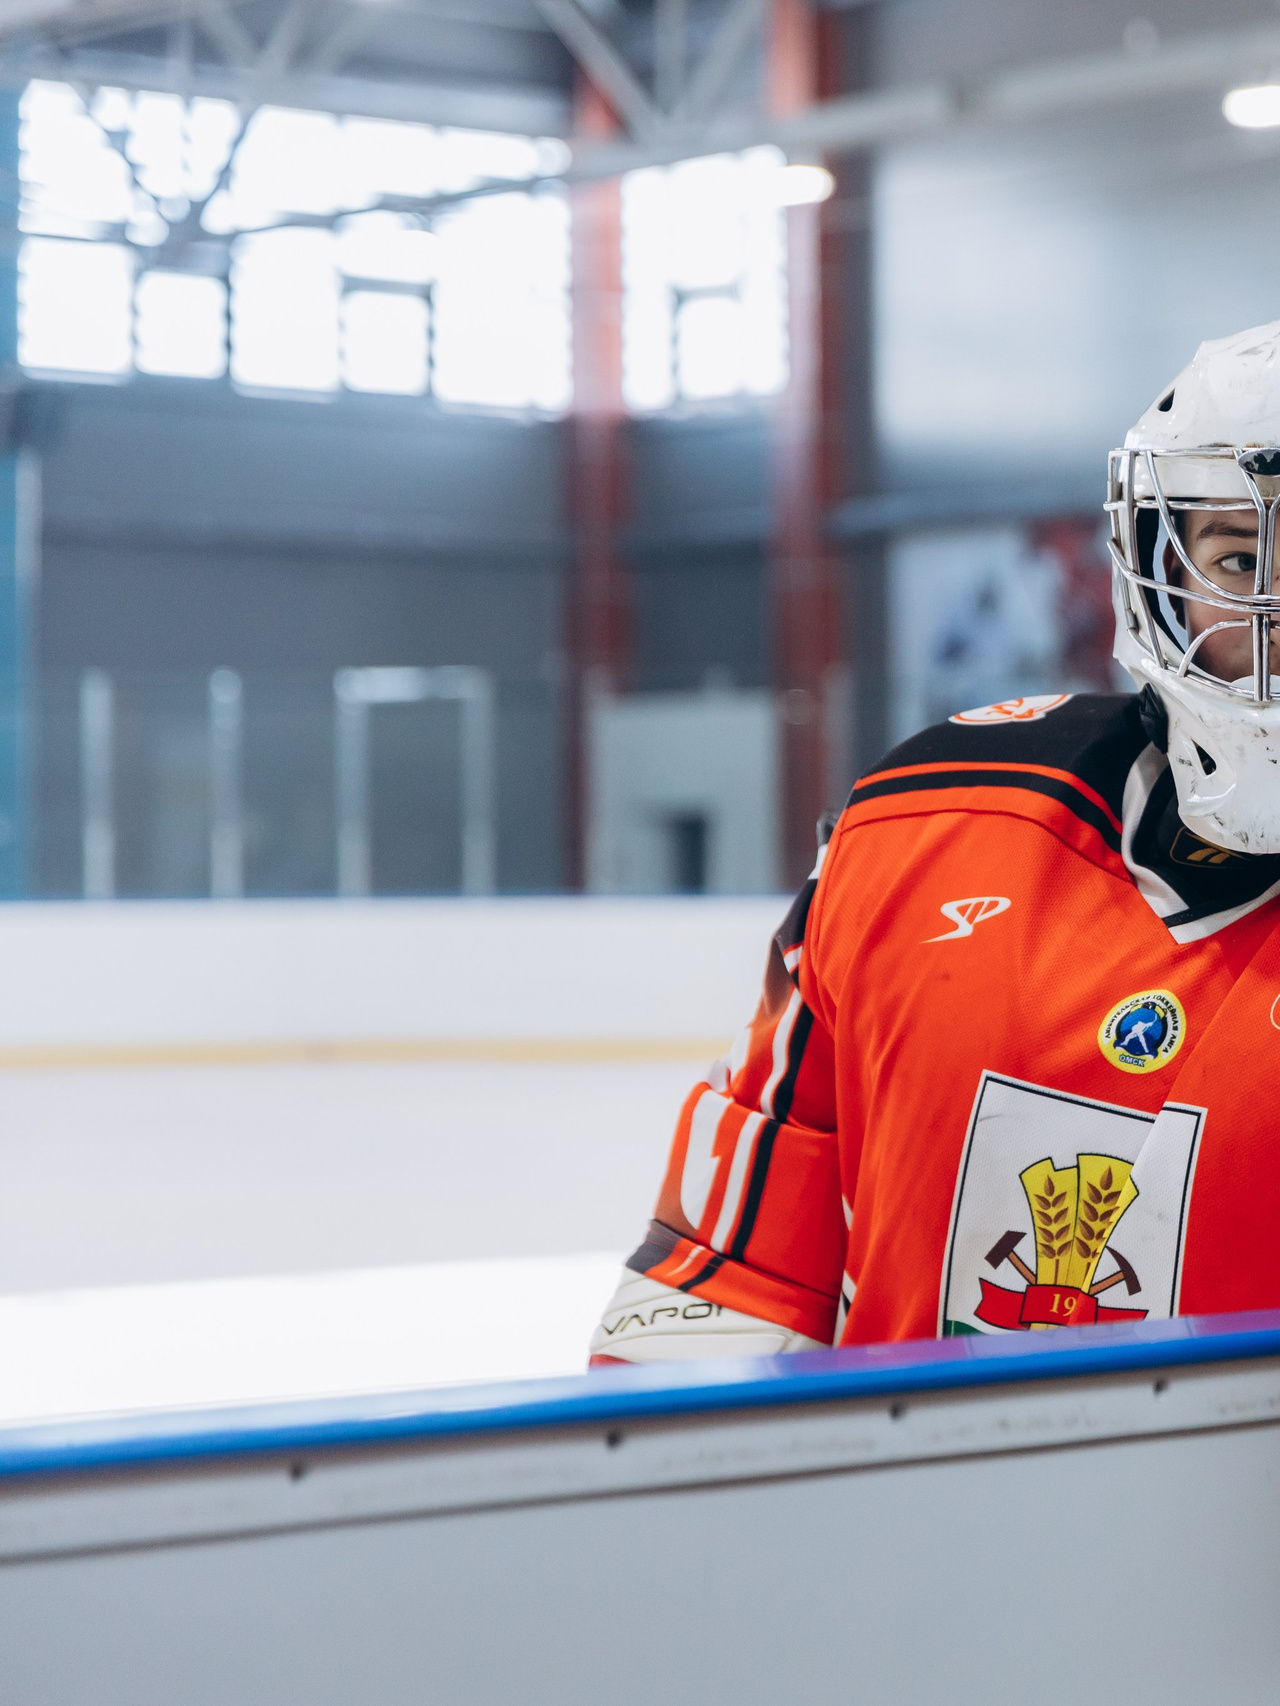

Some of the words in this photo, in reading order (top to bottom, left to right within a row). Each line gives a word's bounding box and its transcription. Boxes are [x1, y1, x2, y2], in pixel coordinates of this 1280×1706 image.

[1152, 994, 1179, 1032] ХОККЕЙНАЯ
[1162, 1033, 1177, 1054] ЛИГА
[1119, 1054, 1145, 1067] ОМСК
[1049, 1293, 1077, 1317] 19
